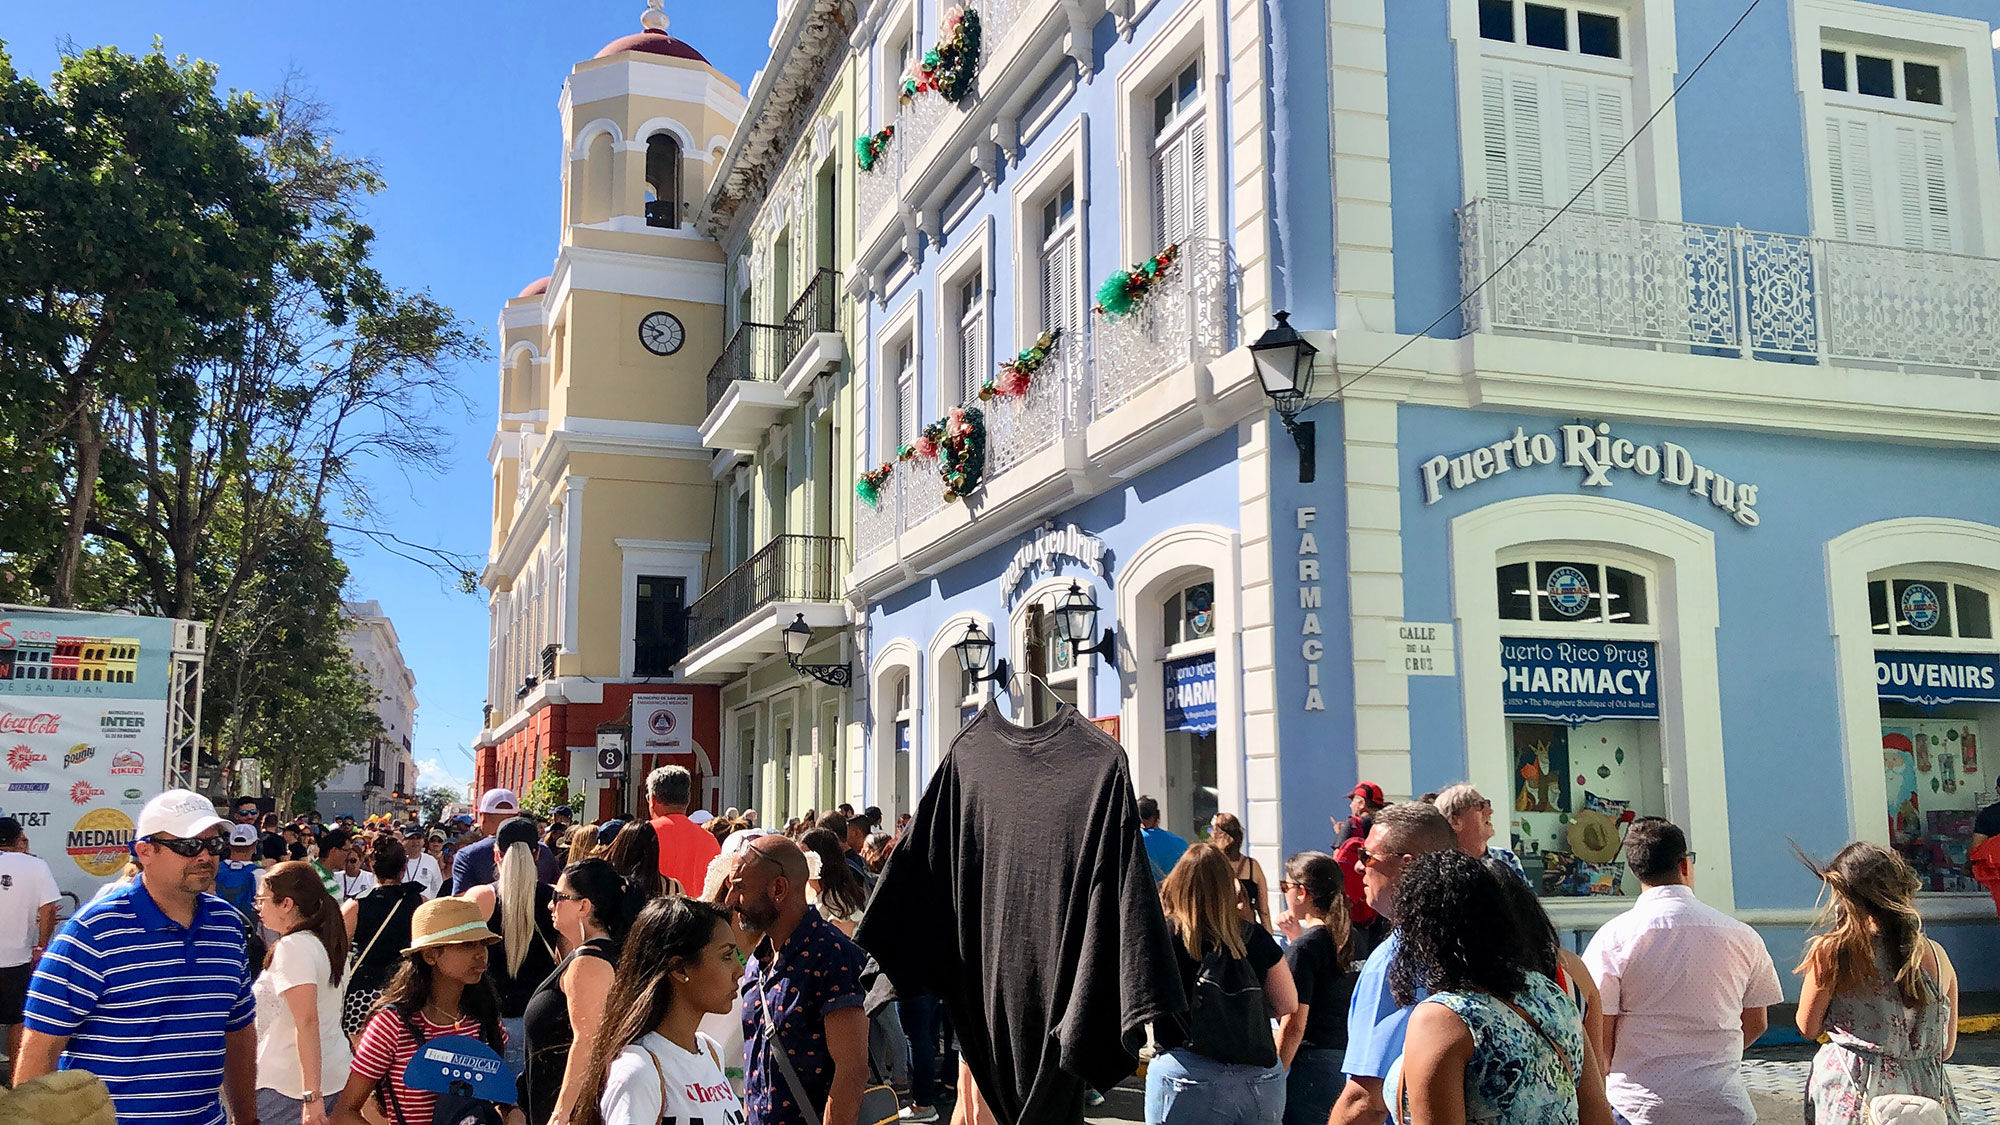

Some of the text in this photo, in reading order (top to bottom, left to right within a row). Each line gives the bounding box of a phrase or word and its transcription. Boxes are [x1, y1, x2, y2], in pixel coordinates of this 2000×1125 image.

[1422, 421, 1761, 528] Puerto Rico Drug
[1066, 523, 1105, 577] Drug
[1297, 506, 1326, 712] FARMACIA
[1400, 627, 1435, 640] CALLE
[1406, 644, 1431, 654] DE LA
[1557, 642, 1600, 664] Rico
[1603, 643, 1649, 669] Drug
[1405, 657, 1433, 671] CRUZ
[25, 683, 54, 692] SAN
[65, 684, 104, 694] JUAN
[1607, 700, 1615, 709] of
[100, 716, 145, 727] INTER
[18, 754, 48, 762] SUIZA
[63, 746, 96, 769] Bounty
[605, 752, 615, 765] 8
[110, 767, 144, 775] KIKUET
[452, 1054, 498, 1071] MEDICAL
[685, 1081, 733, 1103] Cherry
